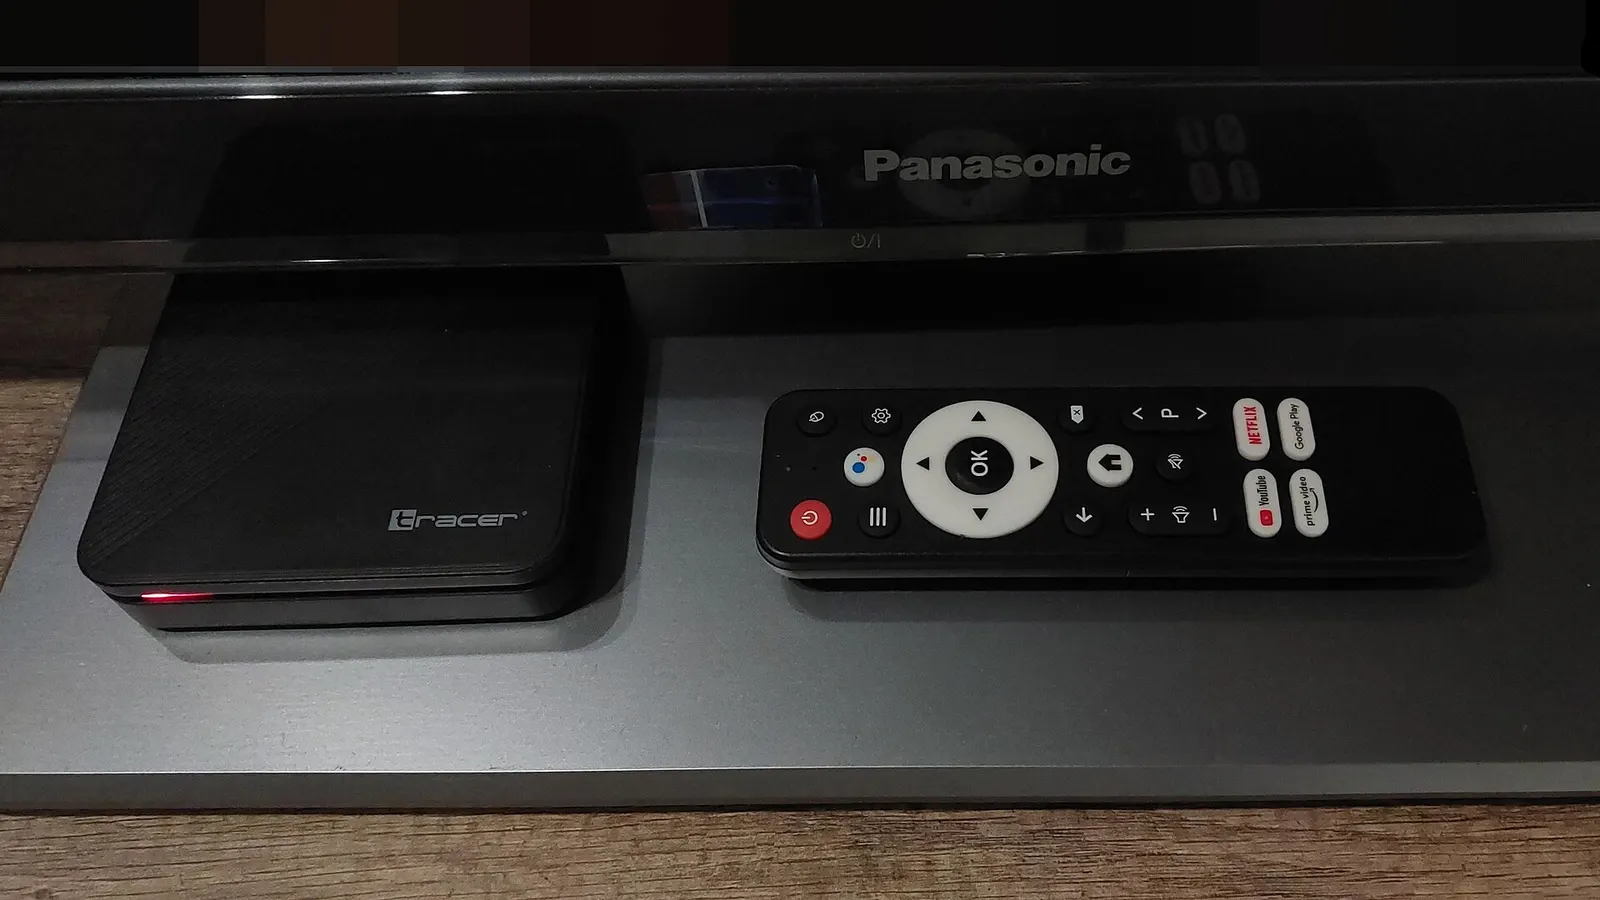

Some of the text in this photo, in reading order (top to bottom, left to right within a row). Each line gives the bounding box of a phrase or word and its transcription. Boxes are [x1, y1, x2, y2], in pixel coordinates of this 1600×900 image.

[864, 144, 1131, 182] Panasonic
[1243, 406, 1263, 445] NETFLIX
[1290, 403, 1304, 450] Google Play
[970, 449, 989, 477] OK
[1256, 475, 1270, 506] YouTube
[1299, 476, 1316, 527] prime video
[388, 508, 519, 532] tracer
